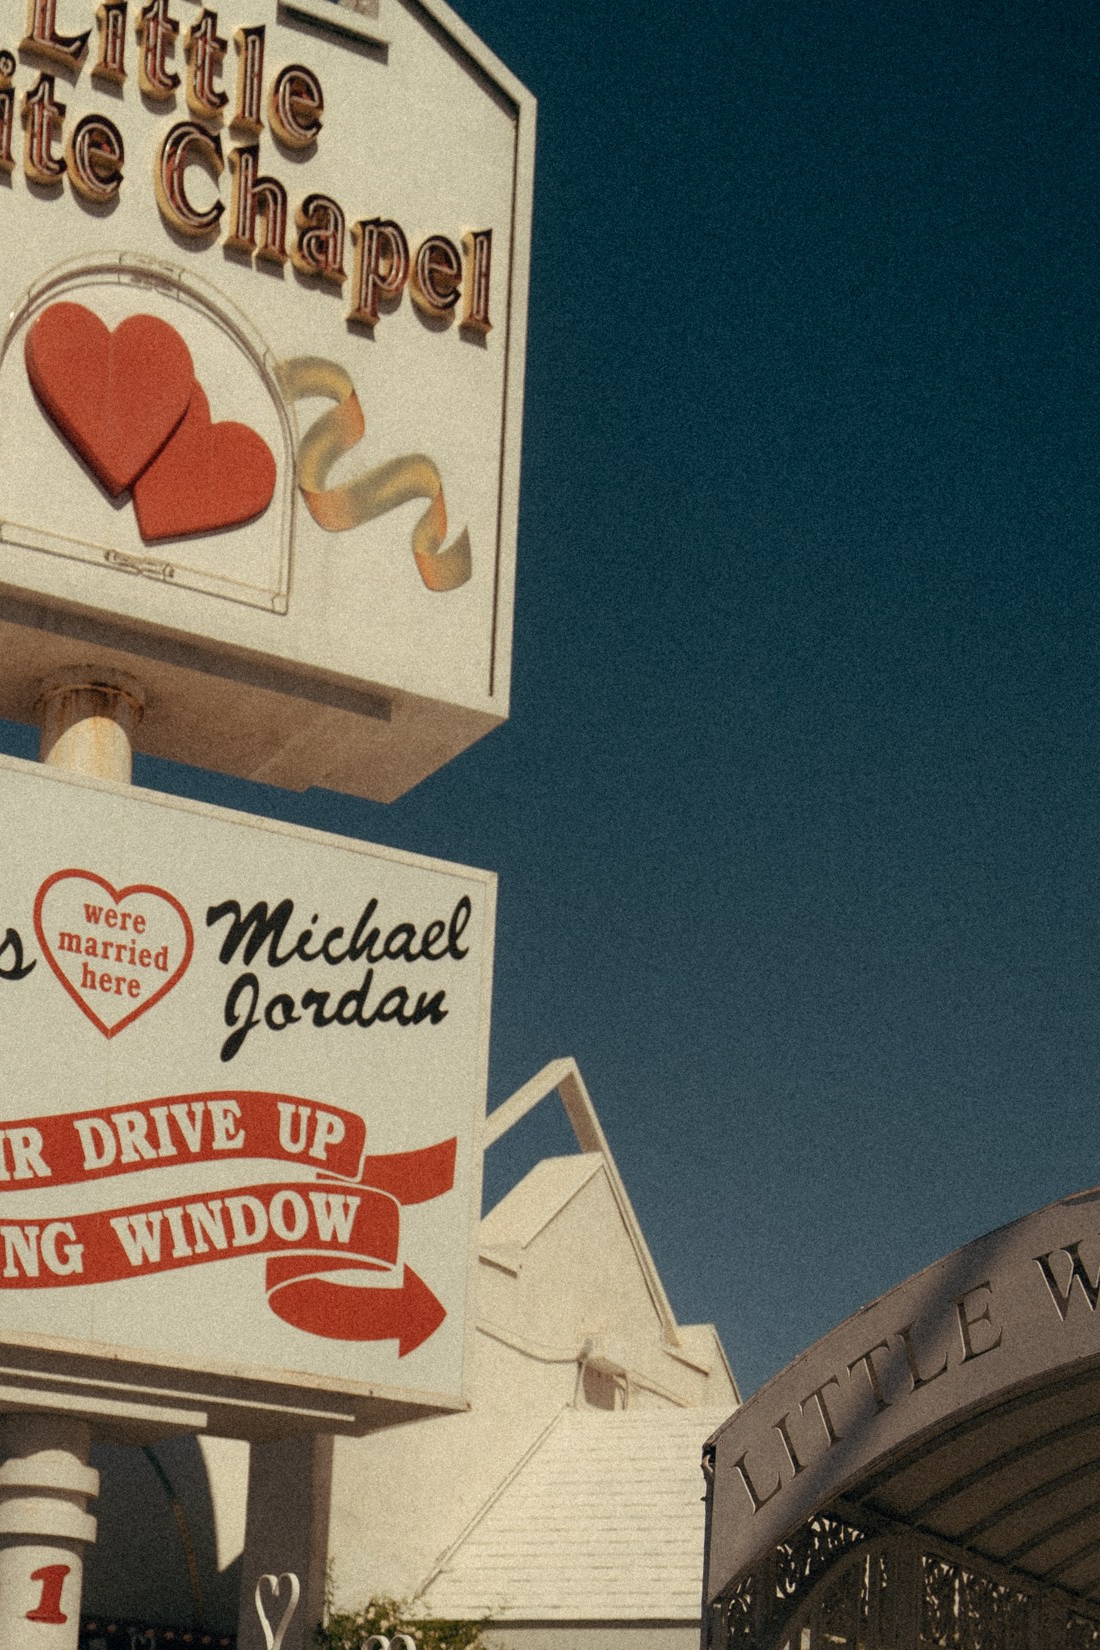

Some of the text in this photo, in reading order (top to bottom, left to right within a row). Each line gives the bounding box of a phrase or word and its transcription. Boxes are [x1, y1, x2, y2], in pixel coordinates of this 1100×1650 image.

[17, 0, 325, 148] Little
[154, 121, 493, 334] Chapel
[57, 931, 169, 972] married
[83, 903, 147, 934] were
[206, 896, 471, 966] Michael
[80, 961, 142, 998] here
[220, 969, 448, 1061] Jordan
[74, 1100, 245, 1169] DRIVE
[277, 1102, 346, 1160] UP
[110, 1191, 361, 1266] WINDOW
[731, 1280, 1003, 1516] LITTLE
